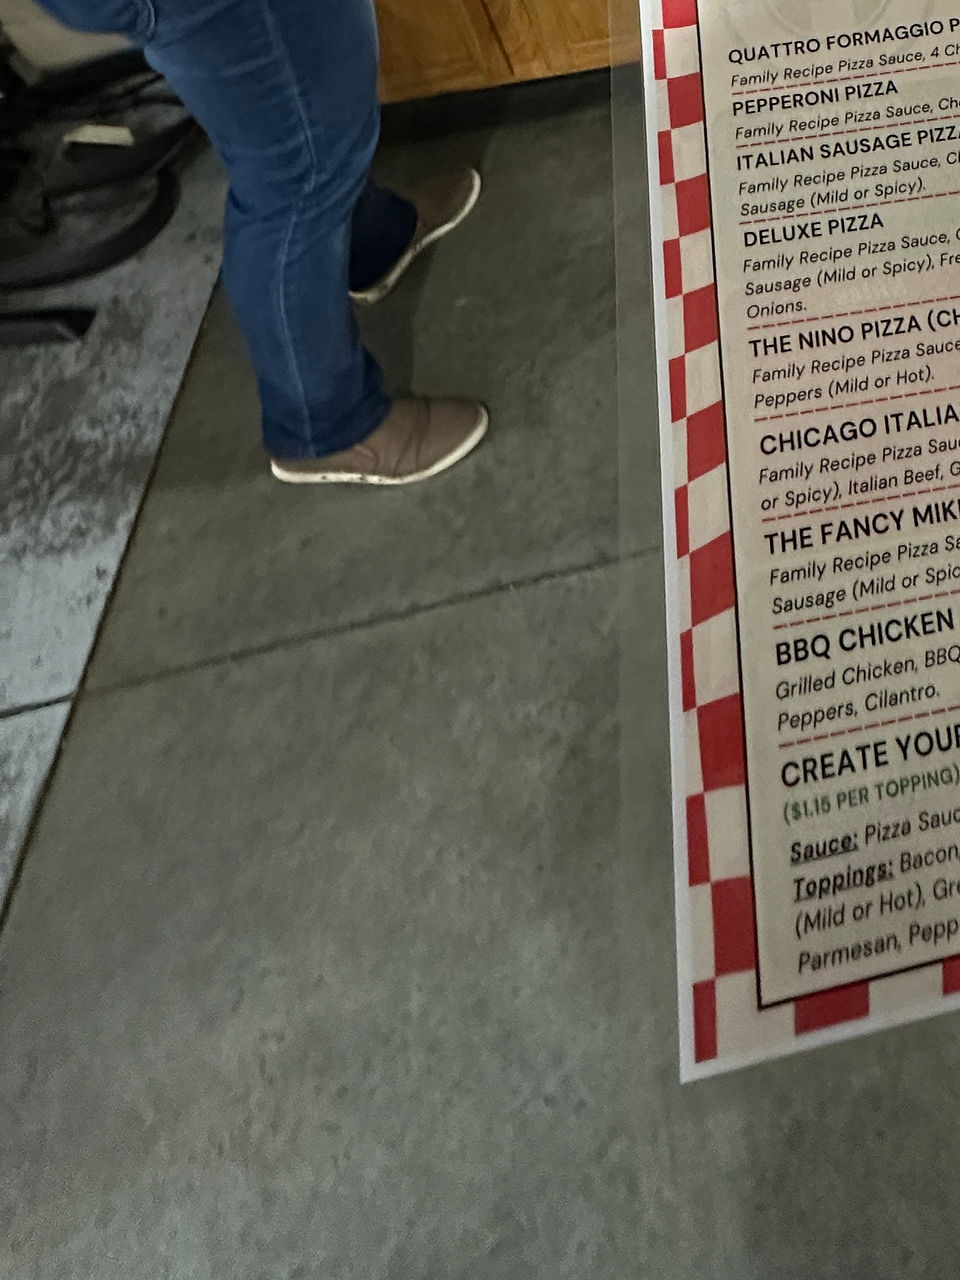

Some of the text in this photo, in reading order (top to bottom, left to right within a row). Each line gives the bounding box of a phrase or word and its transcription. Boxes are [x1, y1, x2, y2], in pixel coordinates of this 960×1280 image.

[728, 37, 821, 66] QUATTRO
[825, 19, 945, 51] FORMAGGIO
[730, 68, 779, 88] Family
[783, 63, 834, 81] Recipe
[837, 58, 874, 73] Pizza
[878, 51, 926, 67] Sauce,
[930, 45, 940, 58] 4
[732, 79, 899, 117] PEPPERONI PIZZA
[736, 145, 815, 172] ITALIAN
[818, 131, 913, 160] SAUSAGE
[743, 212, 885, 248] DELUXE PIZZA
[744, 276, 812, 297] Sausage
[816, 264, 856, 288] (Mild
[860, 266, 878, 279] or
[882, 252, 935, 278] Spicy),
[747, 334, 793, 358] THE
[798, 325, 855, 351] NINO
[860, 314, 923, 341] PIZZA
[753, 363, 935, 410] Peppers (Mild or Hot).
[759, 417, 878, 456] CHICAGO
[763, 525, 814, 556] THE
[820, 507, 905, 546] FANCY
[771, 587, 848, 616] Sausage
[851, 573, 896, 602] (Mild
[901, 573, 920, 590] or
[775, 633, 832, 667] BBQ
[838, 606, 955, 653] CHICKEN
[775, 668, 836, 702] Grilled
[841, 658, 919, 686] Chicken,
[777, 683, 941, 732] Peppers, Cilantro.
[780, 739, 890, 789] CREATE
[836, 785, 869, 811] PER
[874, 762, 960, 801] TOPPING)
[864, 817, 912, 847] Pizza
[795, 901, 846, 942] (Mild
[852, 900, 874, 923] or
